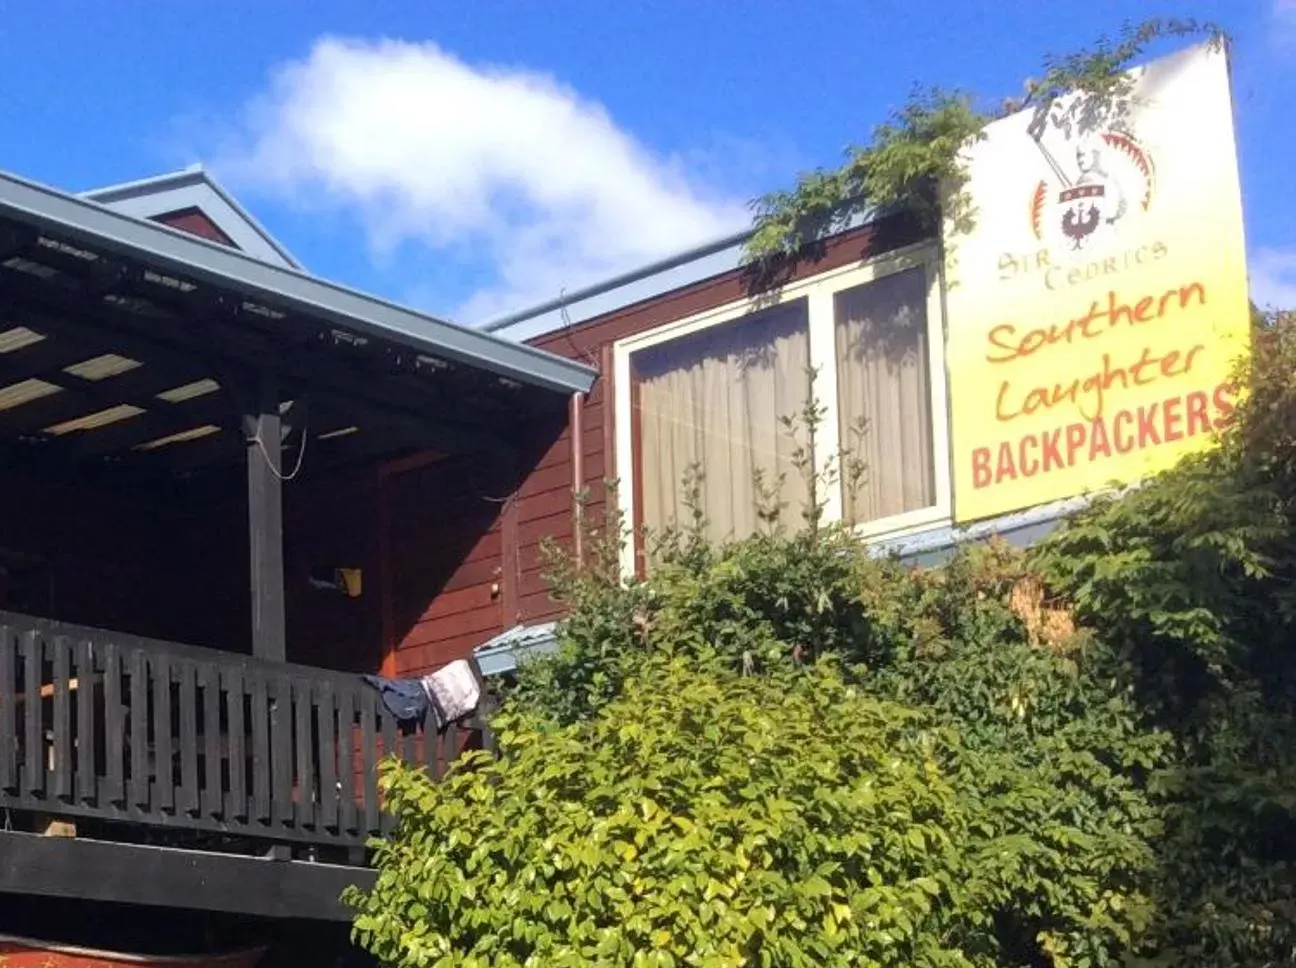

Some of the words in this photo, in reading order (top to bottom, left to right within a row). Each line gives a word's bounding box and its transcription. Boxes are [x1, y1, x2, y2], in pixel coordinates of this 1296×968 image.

[986, 282, 1207, 362] Southern
[995, 344, 1205, 422] Laughter
[970, 382, 1237, 489] BACKPACKERS
